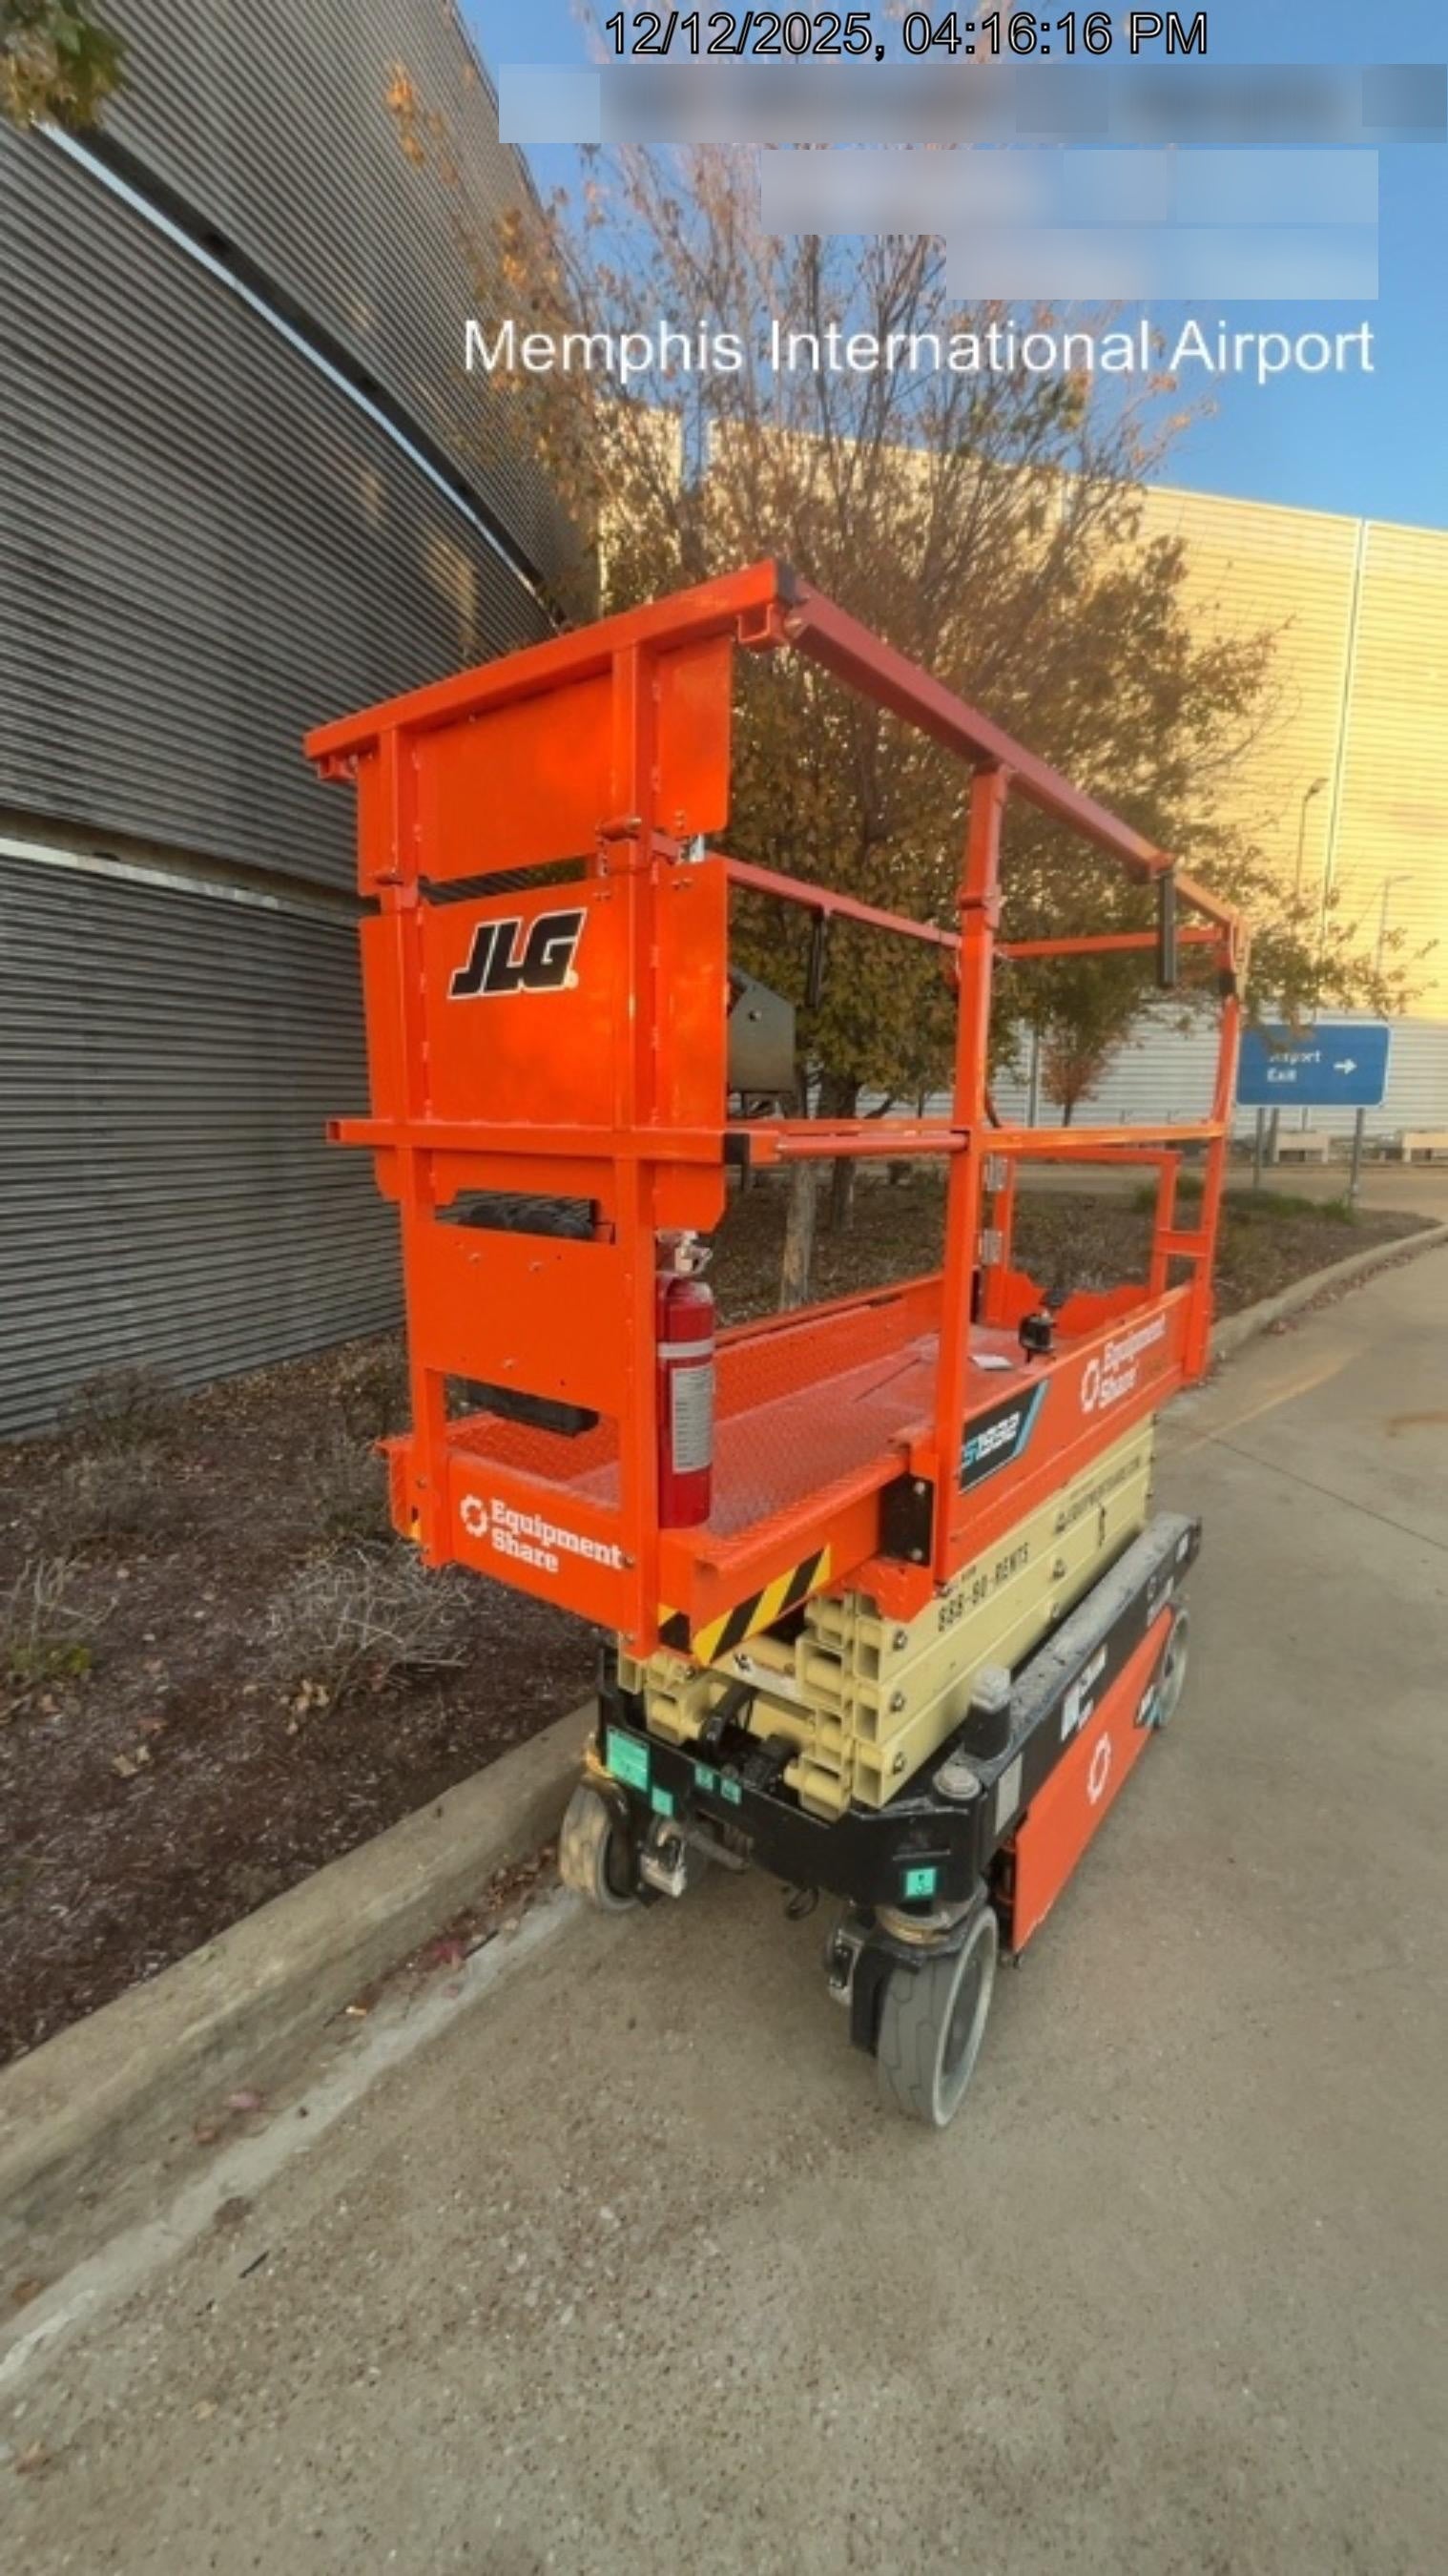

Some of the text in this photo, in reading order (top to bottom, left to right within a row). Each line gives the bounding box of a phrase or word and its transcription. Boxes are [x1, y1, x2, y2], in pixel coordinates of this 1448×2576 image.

[447, 907, 587, 1000] JLG
[1267, 1067, 1297, 1082] Exit
[490, 1498, 624, 1570] Equipment
[491, 1527, 560, 1572] Share
